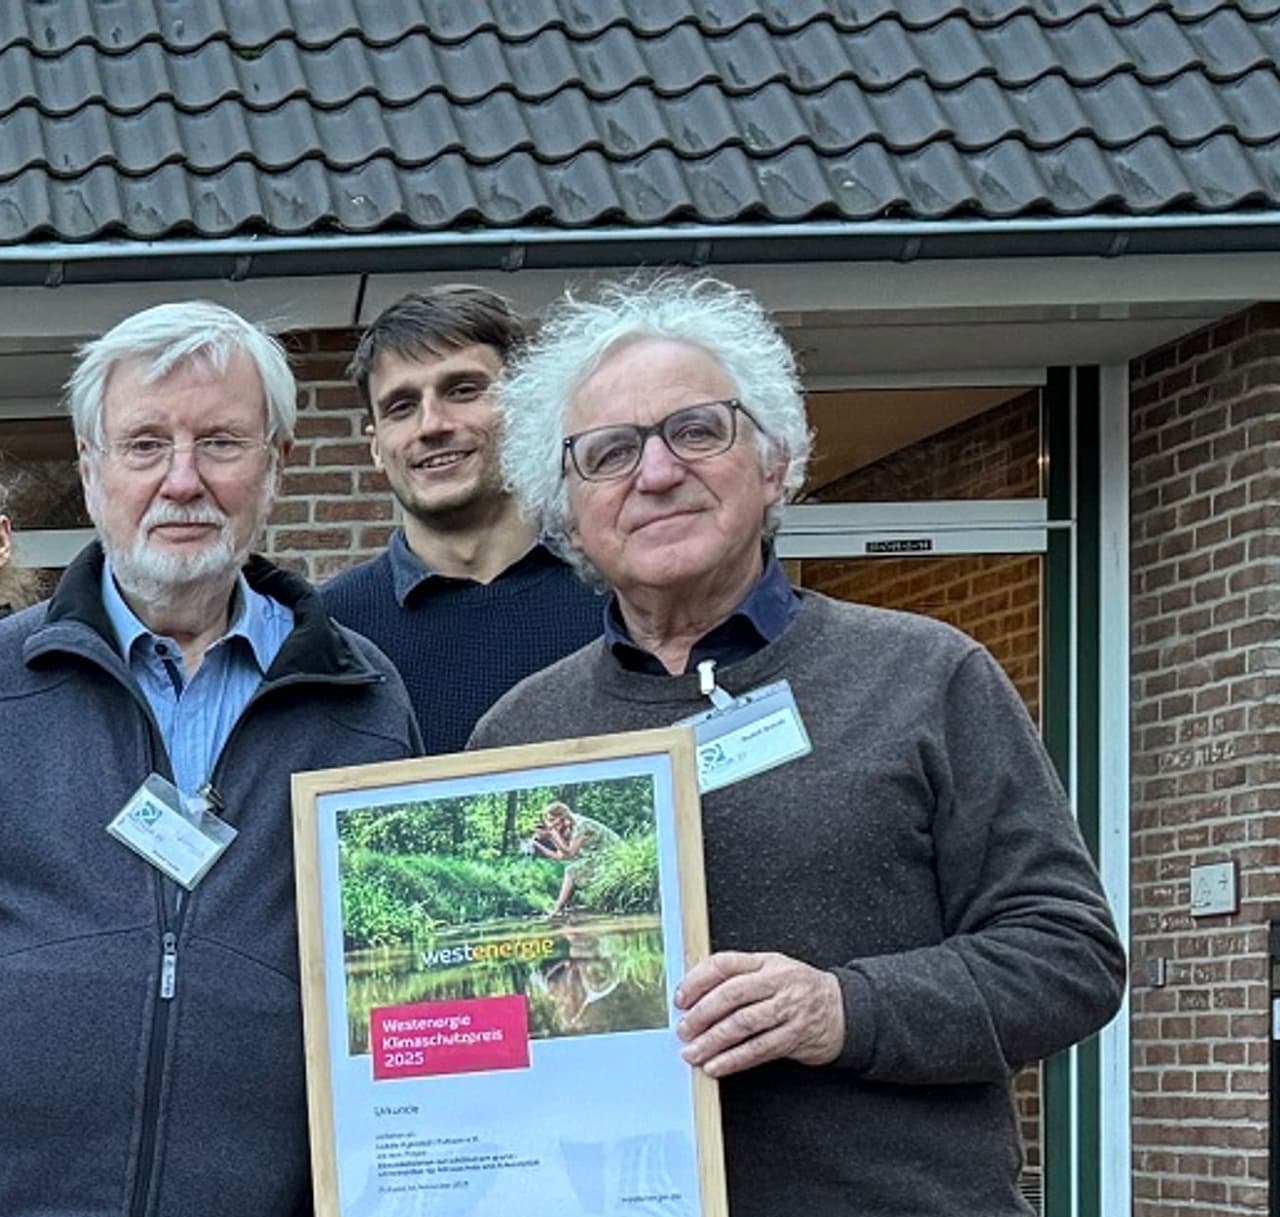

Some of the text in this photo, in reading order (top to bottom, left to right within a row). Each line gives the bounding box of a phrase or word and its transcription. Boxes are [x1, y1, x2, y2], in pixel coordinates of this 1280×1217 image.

[421, 938, 555, 967] westenergie
[382, 1014, 472, 1032] Westenergie
[382, 1029, 504, 1050] Klimaschutzpreis
[384, 1051, 425, 1068] 2025
